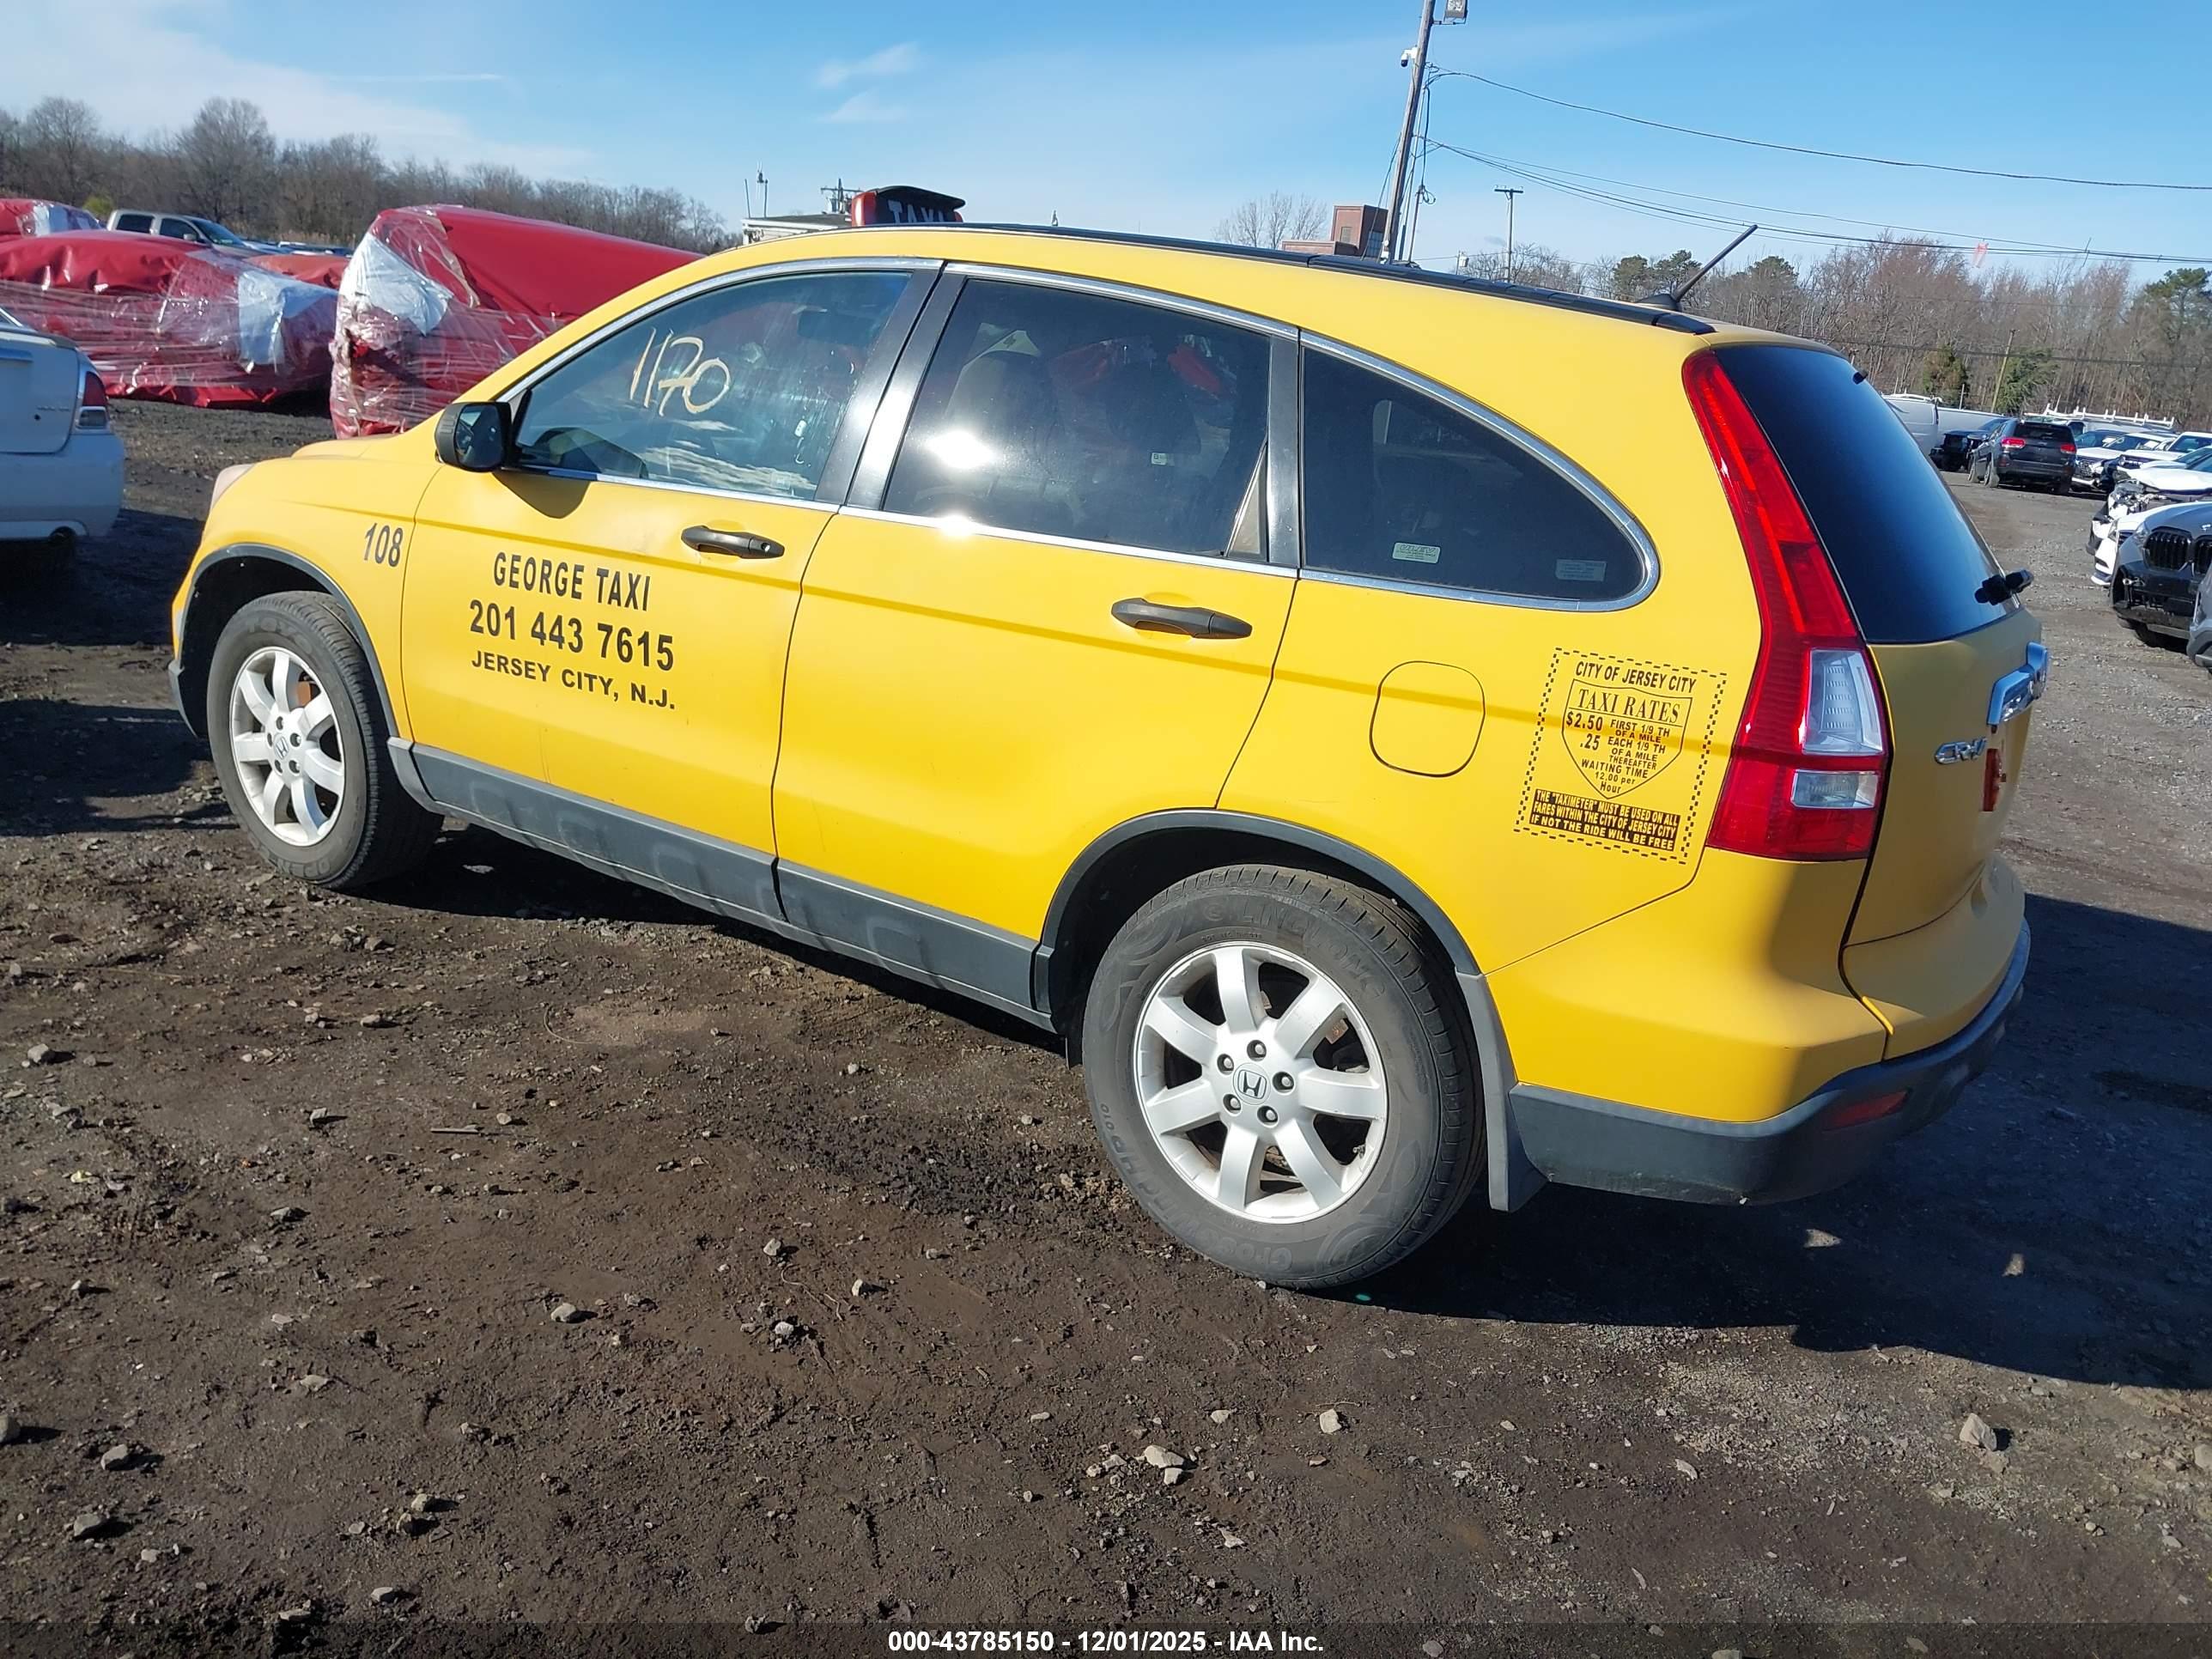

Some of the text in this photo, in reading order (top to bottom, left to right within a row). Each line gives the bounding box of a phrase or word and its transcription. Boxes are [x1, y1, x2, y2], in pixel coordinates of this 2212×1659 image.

[363, 522, 404, 568] 108
[494, 551, 651, 611] GEORGE TAXI
[469, 599, 674, 672] 201 443 7615
[471, 650, 676, 710] JERSEY CITY, N.J.
[1576, 661, 1697, 693] CITY OF JERSEY CITY
[1578, 689, 1680, 723] TAXI RATES
[1566, 711, 1603, 732] $2.50
[1610, 719, 1638, 732] FIRST
[1657, 726, 1670, 738] TH
[1615, 729, 1627, 738] OF
[1638, 733, 1662, 744] MILE
[1580, 733, 1601, 750] .25
[1607, 736, 1633, 749] EACH
[1653, 744, 1666, 754] TH
[1611, 747, 1657, 763] OF A MILE
[1581, 758, 1649, 779] WAITING TIME
[1595, 771, 1635, 785] 12.00 per
[1609, 755, 1657, 771] THEREAFTER
[1600, 781, 1621, 794] Hour
[1533, 801, 1676, 839] FARES WITHIN THE CITY OF JERSEY CITY
[1536, 789, 1551, 803] THE
[1597, 800, 1620, 816] MUST
[1620, 805, 1631, 817] BE
[1631, 807, 1651, 822] USED
[1651, 811, 1664, 824] ON
[1663, 814, 1678, 827] ALL
[1531, 813, 1674, 850] IF NOT THE RIDE WILL BE FREE
